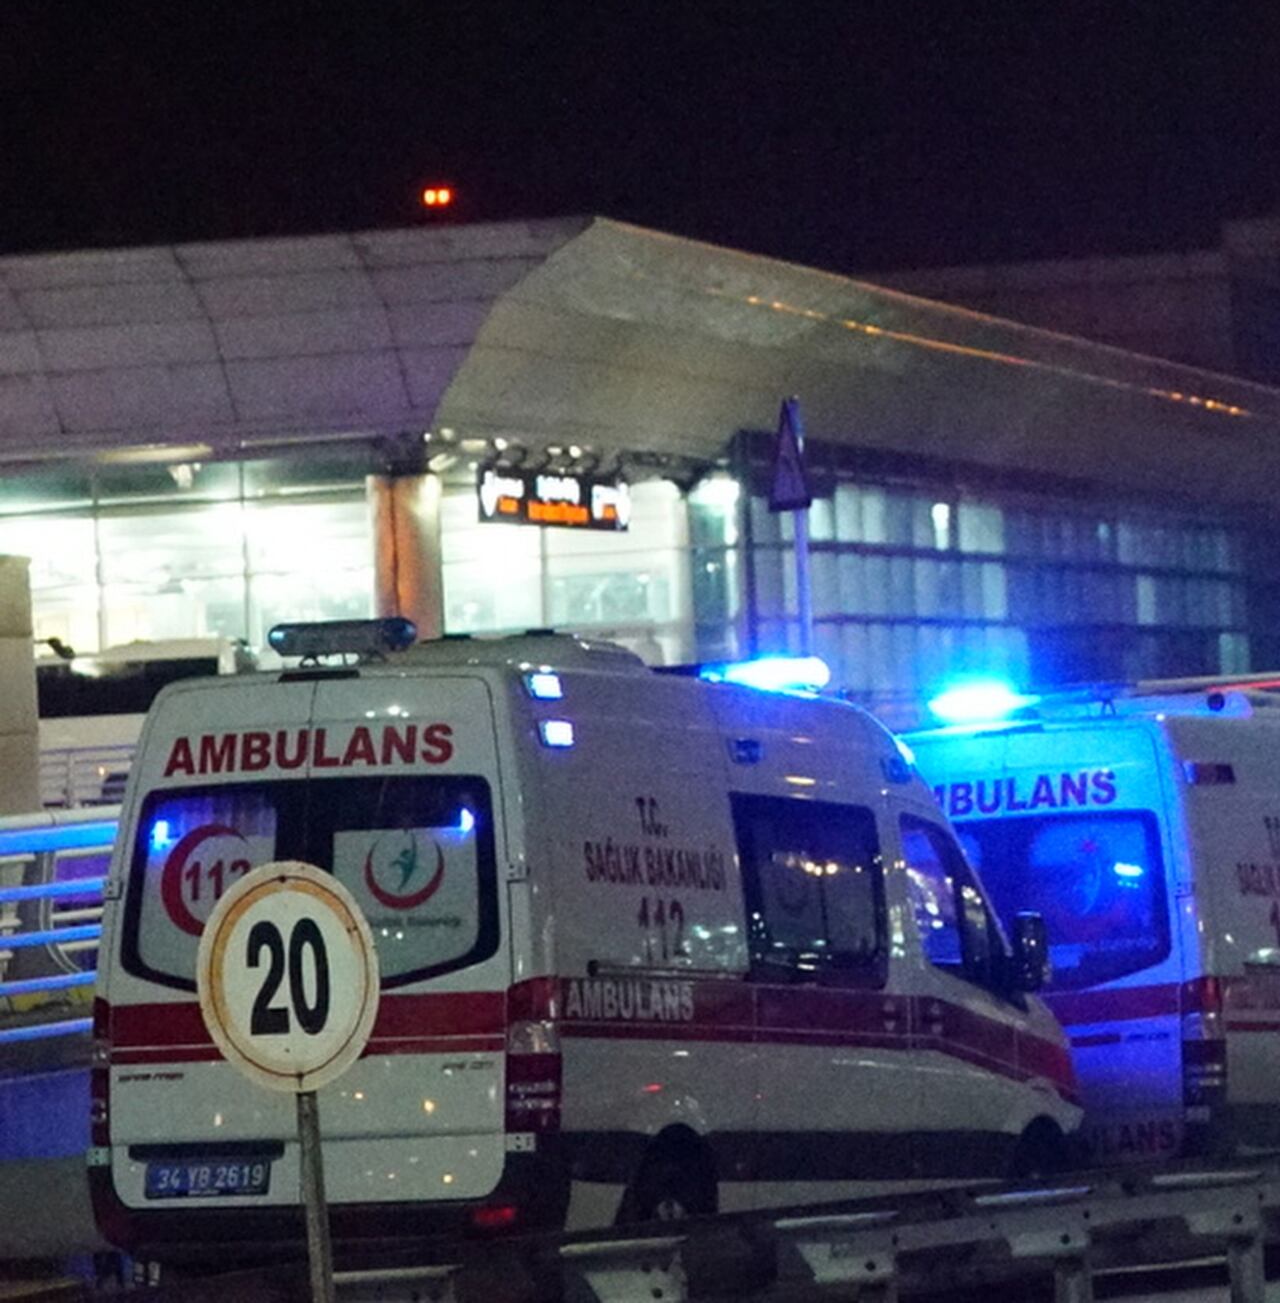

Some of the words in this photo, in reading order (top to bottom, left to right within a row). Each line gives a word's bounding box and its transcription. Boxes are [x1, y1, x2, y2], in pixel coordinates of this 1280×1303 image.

[163, 723, 455, 778] AMBULANS
[638, 897, 686, 962] 112
[245, 916, 331, 1036] 20
[566, 979, 695, 1021] AMBULANS
[157, 1168, 182, 1190] 34
[214, 1164, 265, 1188] 2619
